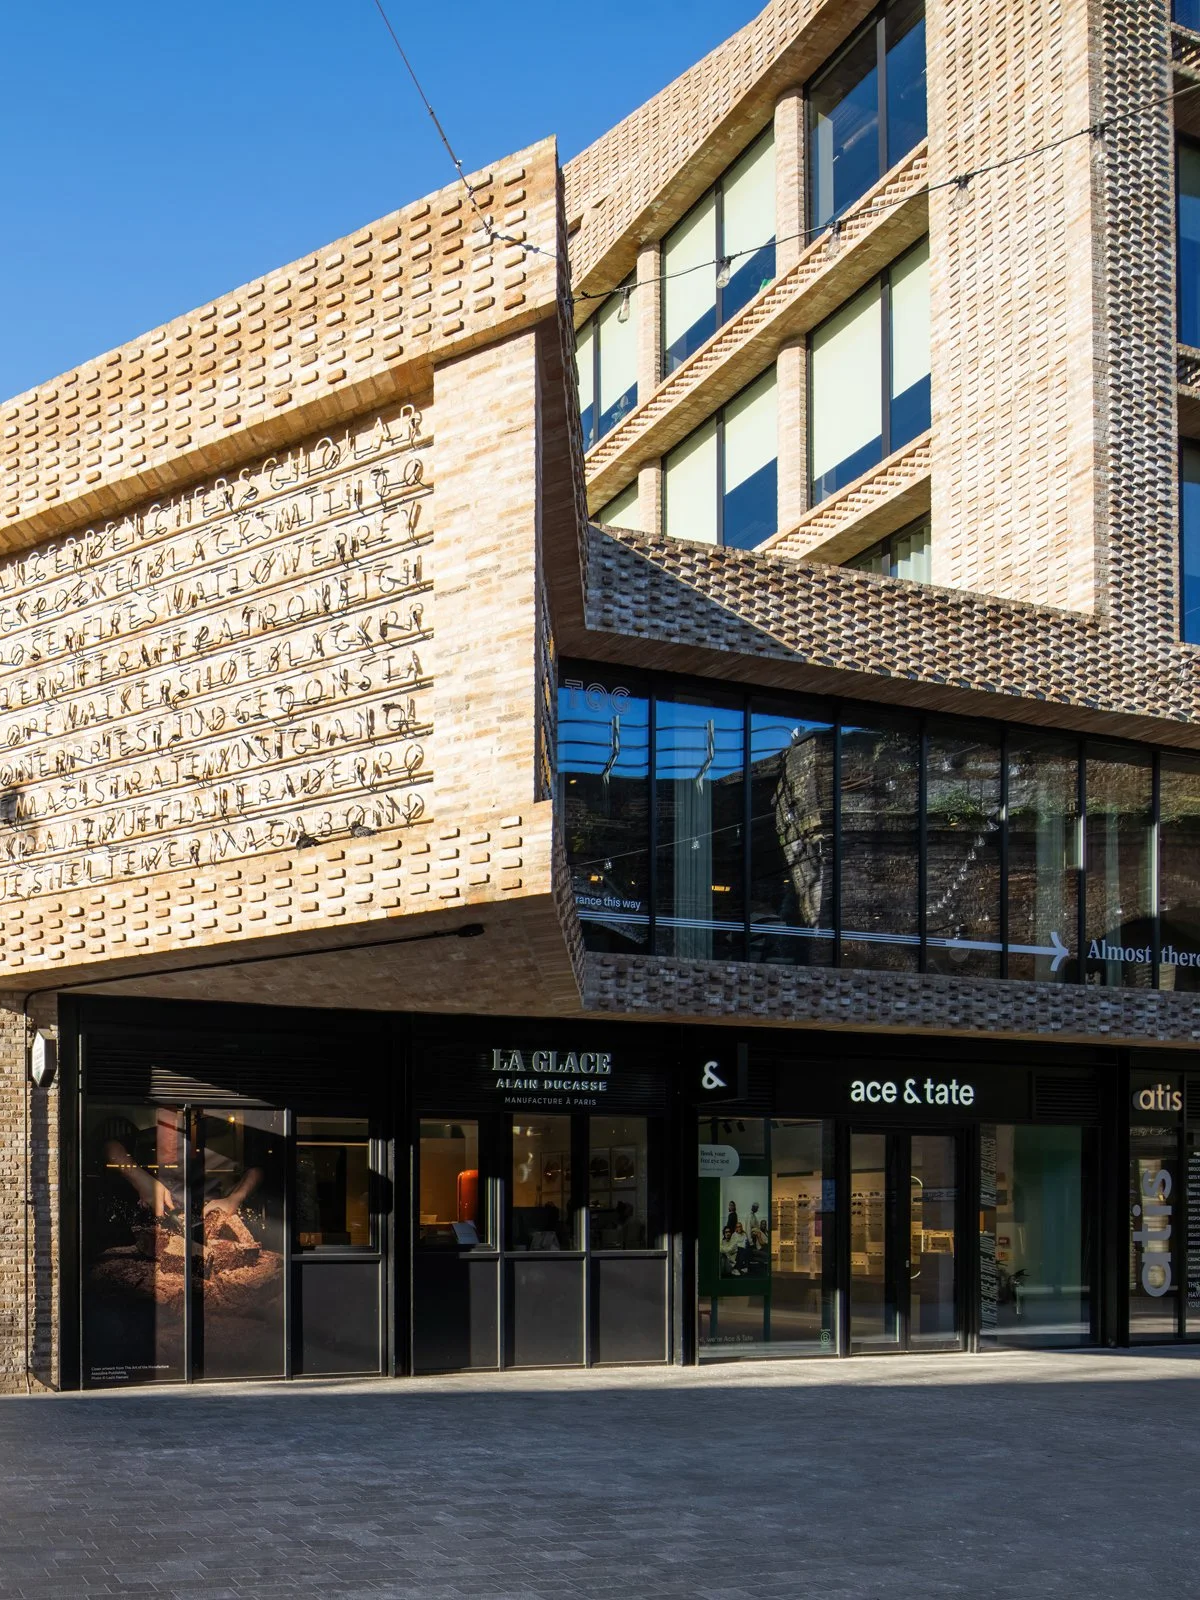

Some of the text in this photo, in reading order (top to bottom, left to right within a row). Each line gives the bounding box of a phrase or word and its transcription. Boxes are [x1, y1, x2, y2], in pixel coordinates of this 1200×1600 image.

[565, 679, 630, 714] TOG
[604, 896, 621, 907] this
[623, 900, 641, 911] way
[1087, 939, 1152, 963] Almost
[492, 1049, 611, 1074] LA GLACE
[701, 1060, 727, 1089] &
[496, 1078, 607, 1091] ALAIN DUCASSE
[850, 1078, 975, 1106] ace & tate
[1138, 1083, 1182, 1111] atis
[505, 1097, 562, 1105] MANUFACTURE
[1132, 1169, 1172, 1297] atis
